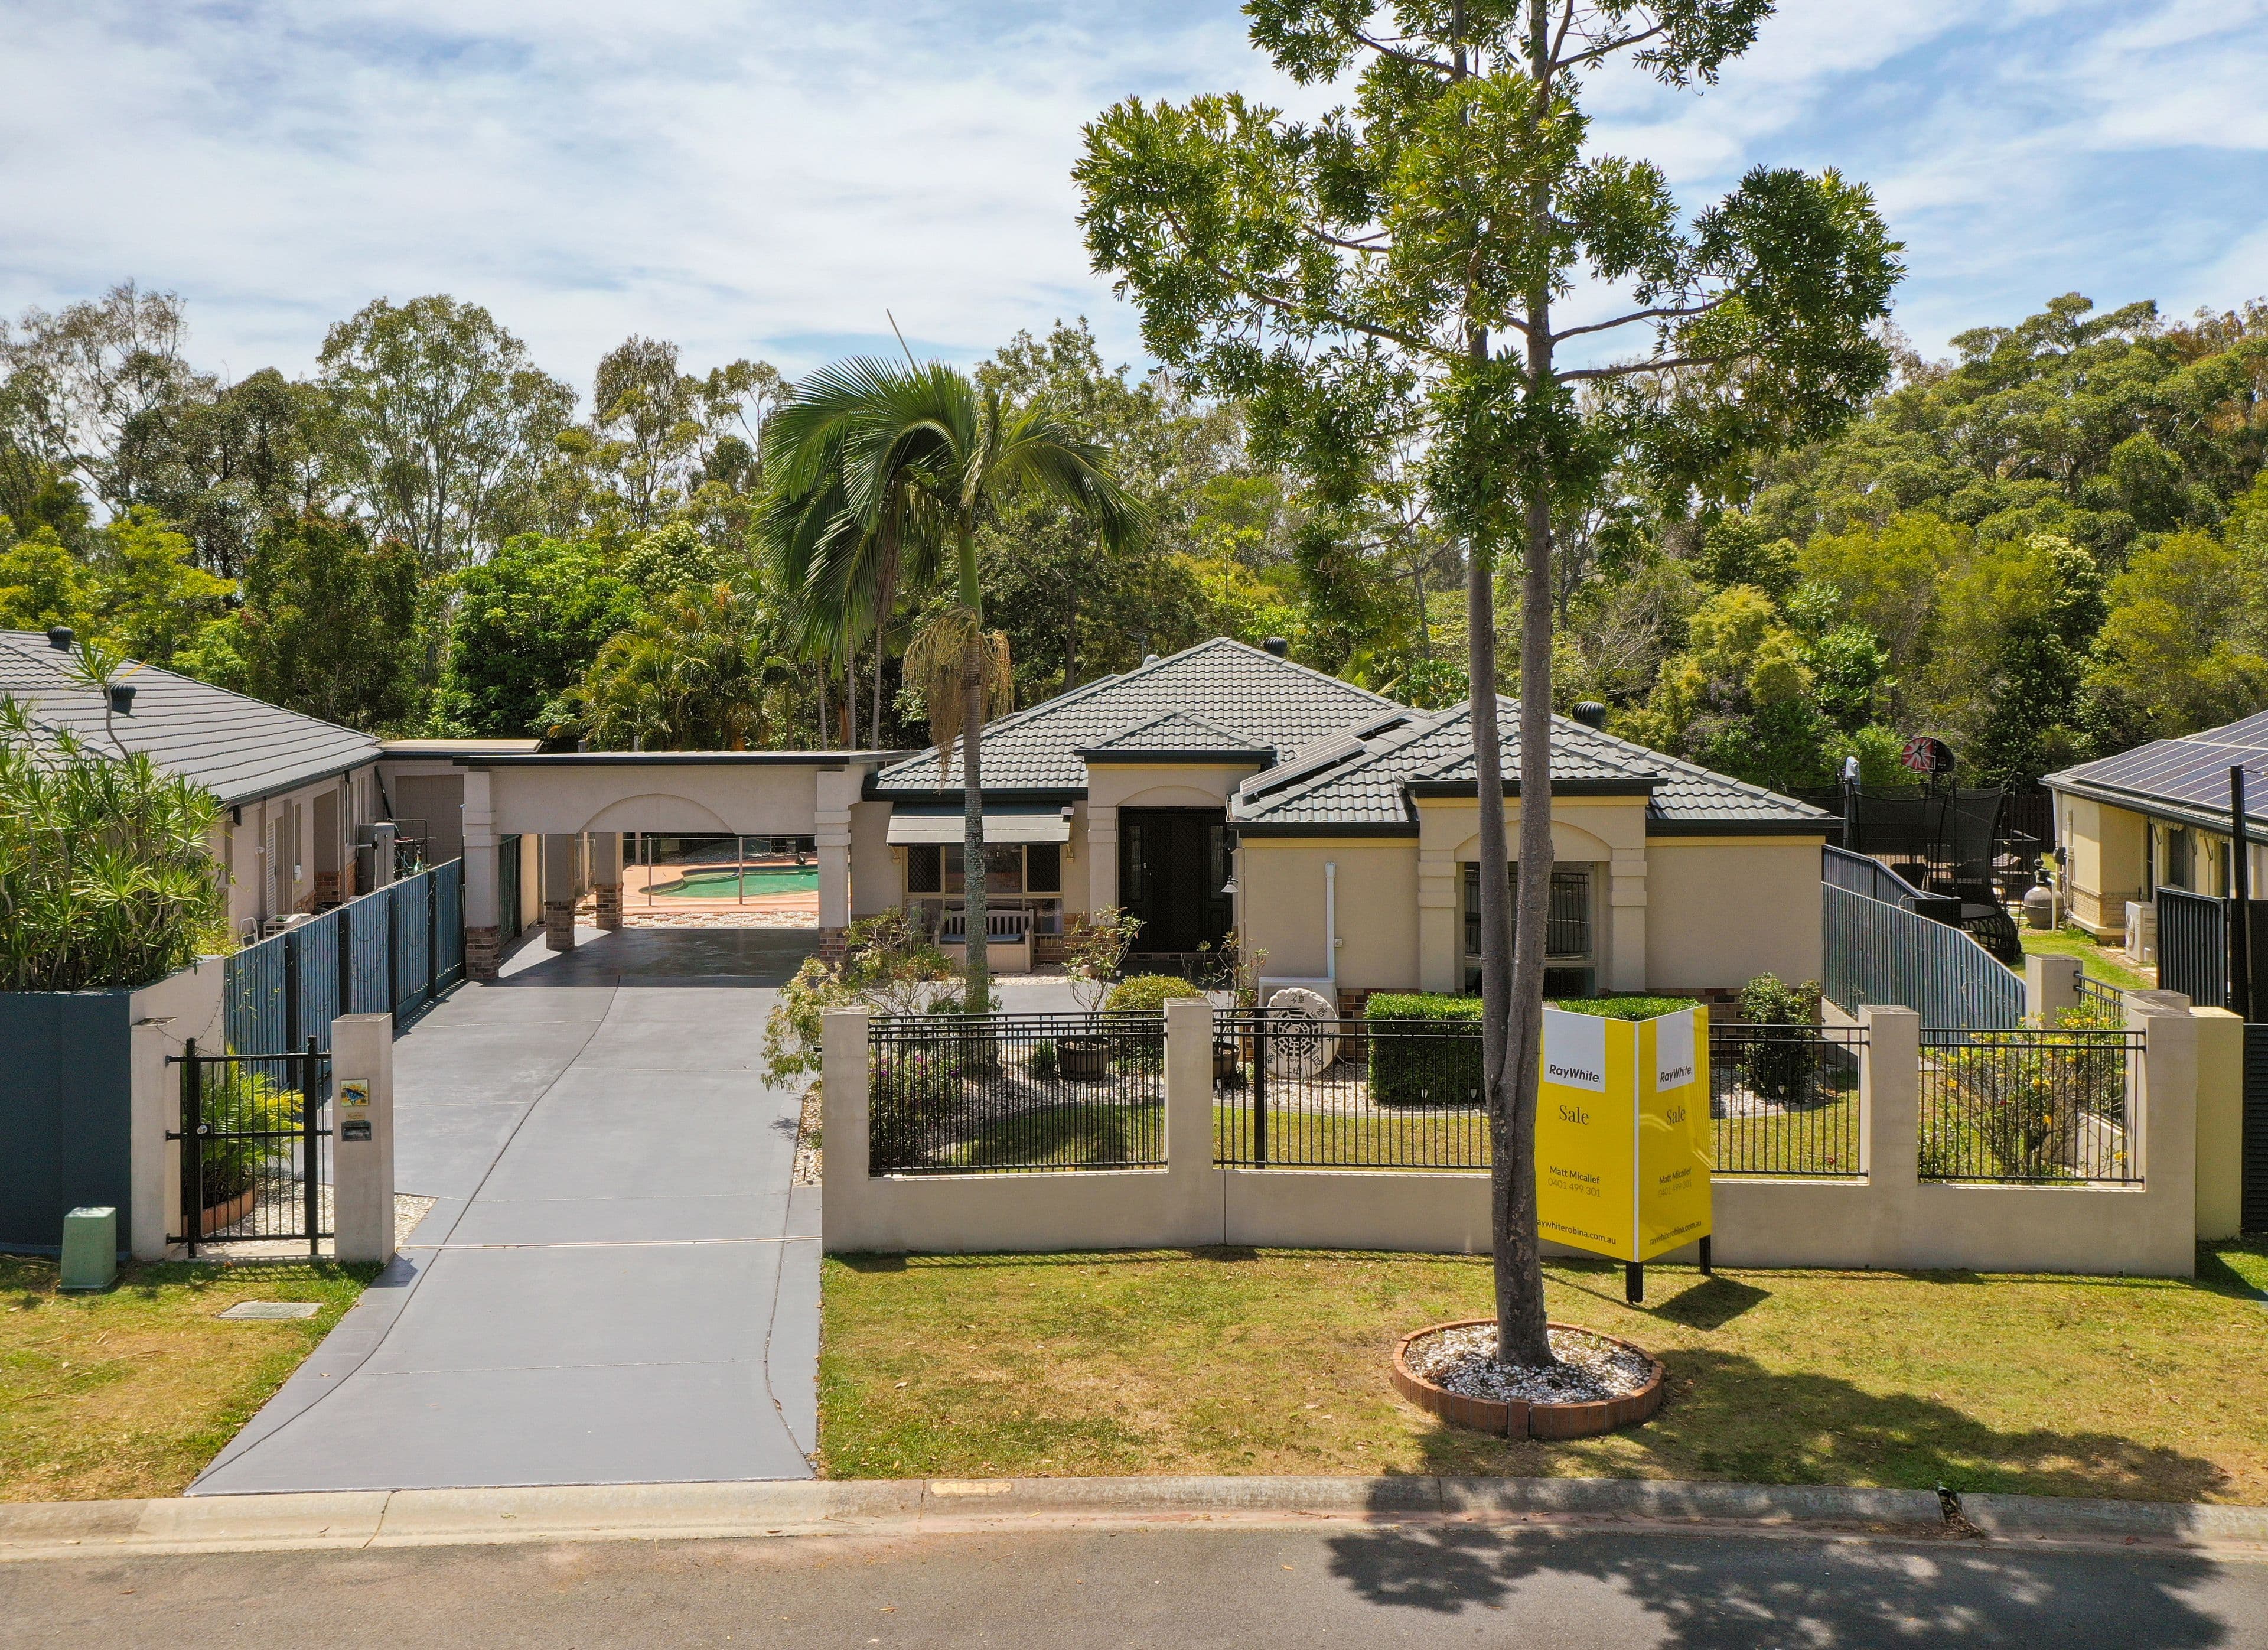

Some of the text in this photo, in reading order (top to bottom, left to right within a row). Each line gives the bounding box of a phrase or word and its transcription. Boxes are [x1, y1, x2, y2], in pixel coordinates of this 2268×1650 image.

[1549, 1064, 1599, 1082] RayWhite
[1660, 1066, 1692, 1083] RayWhite
[1559, 1105, 1589, 1125] Sale
[1666, 1106, 1686, 1125] Sale
[1549, 1165, 1600, 1184] Matt Micallef
[1659, 1175, 1671, 1184] Matt
[1547, 1177, 1601, 1197] 0401 499 301
[1537, 1219, 1617, 1245] aywhiterobina.com.au
